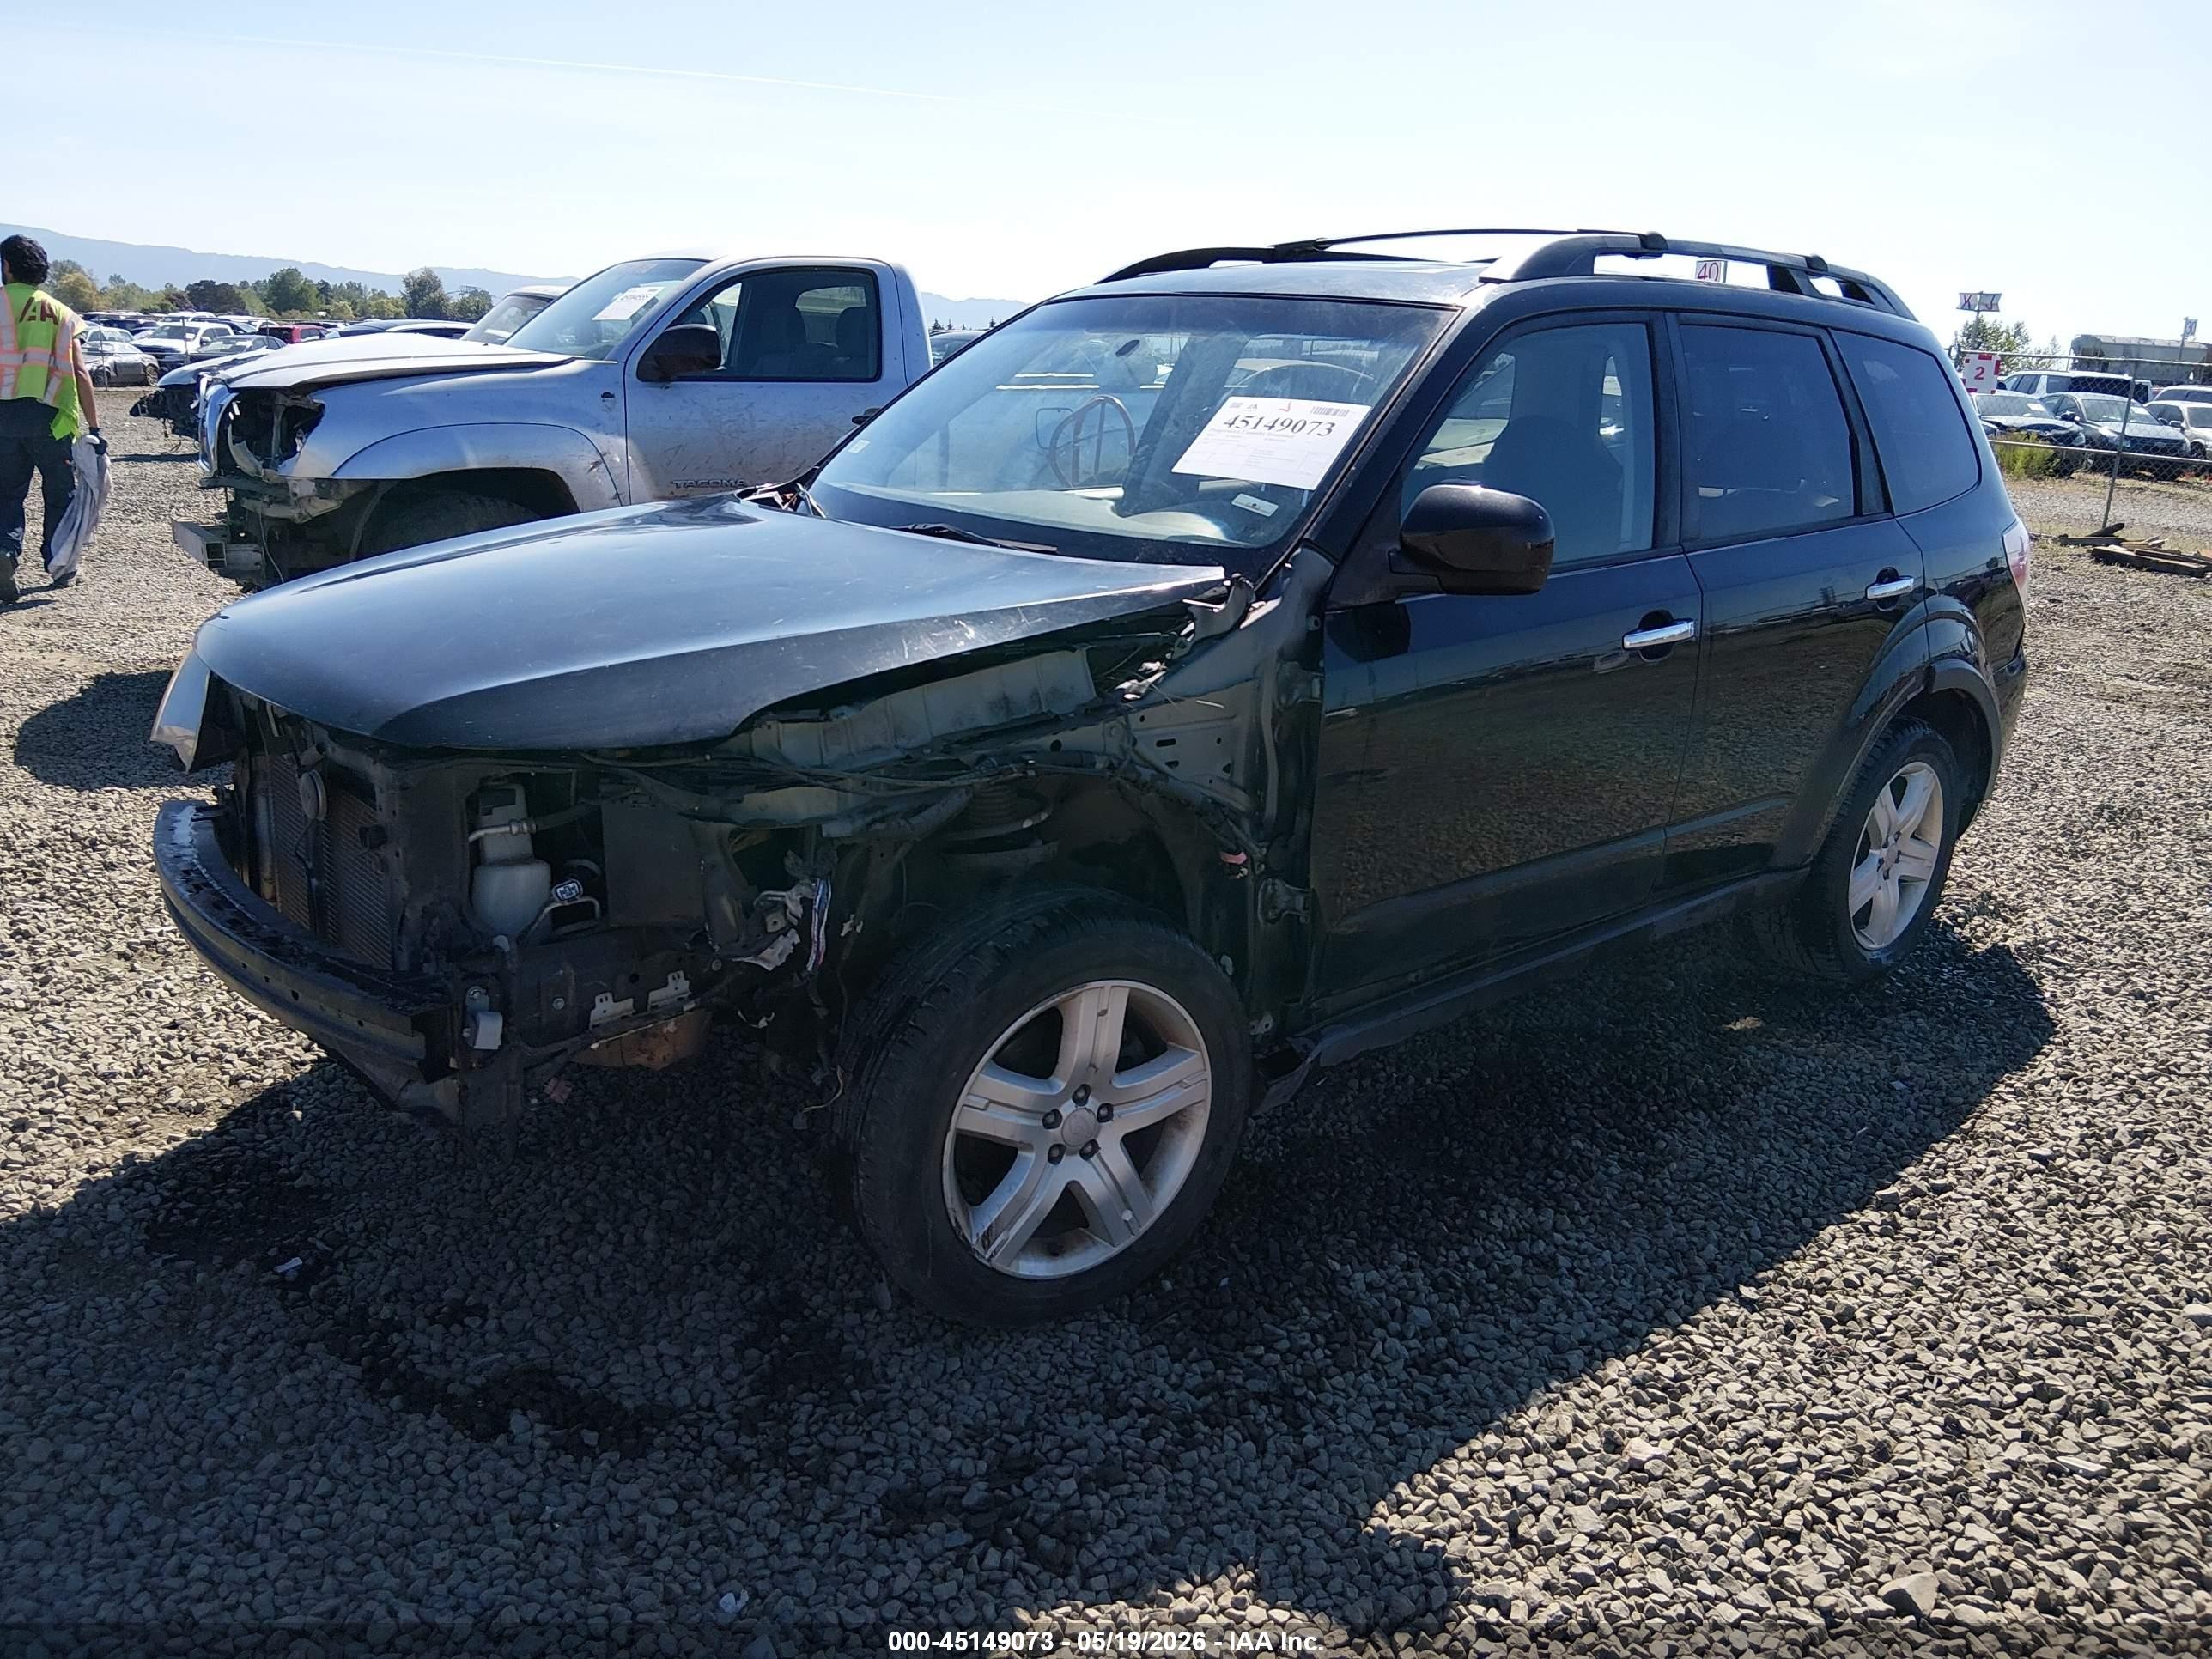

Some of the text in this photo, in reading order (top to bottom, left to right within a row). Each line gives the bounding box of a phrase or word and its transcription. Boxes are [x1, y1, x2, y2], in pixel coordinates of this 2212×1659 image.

[1974, 366, 1985, 380] 2
[1224, 414, 1336, 437] 45149073
[672, 480, 749, 489] TACOMA
